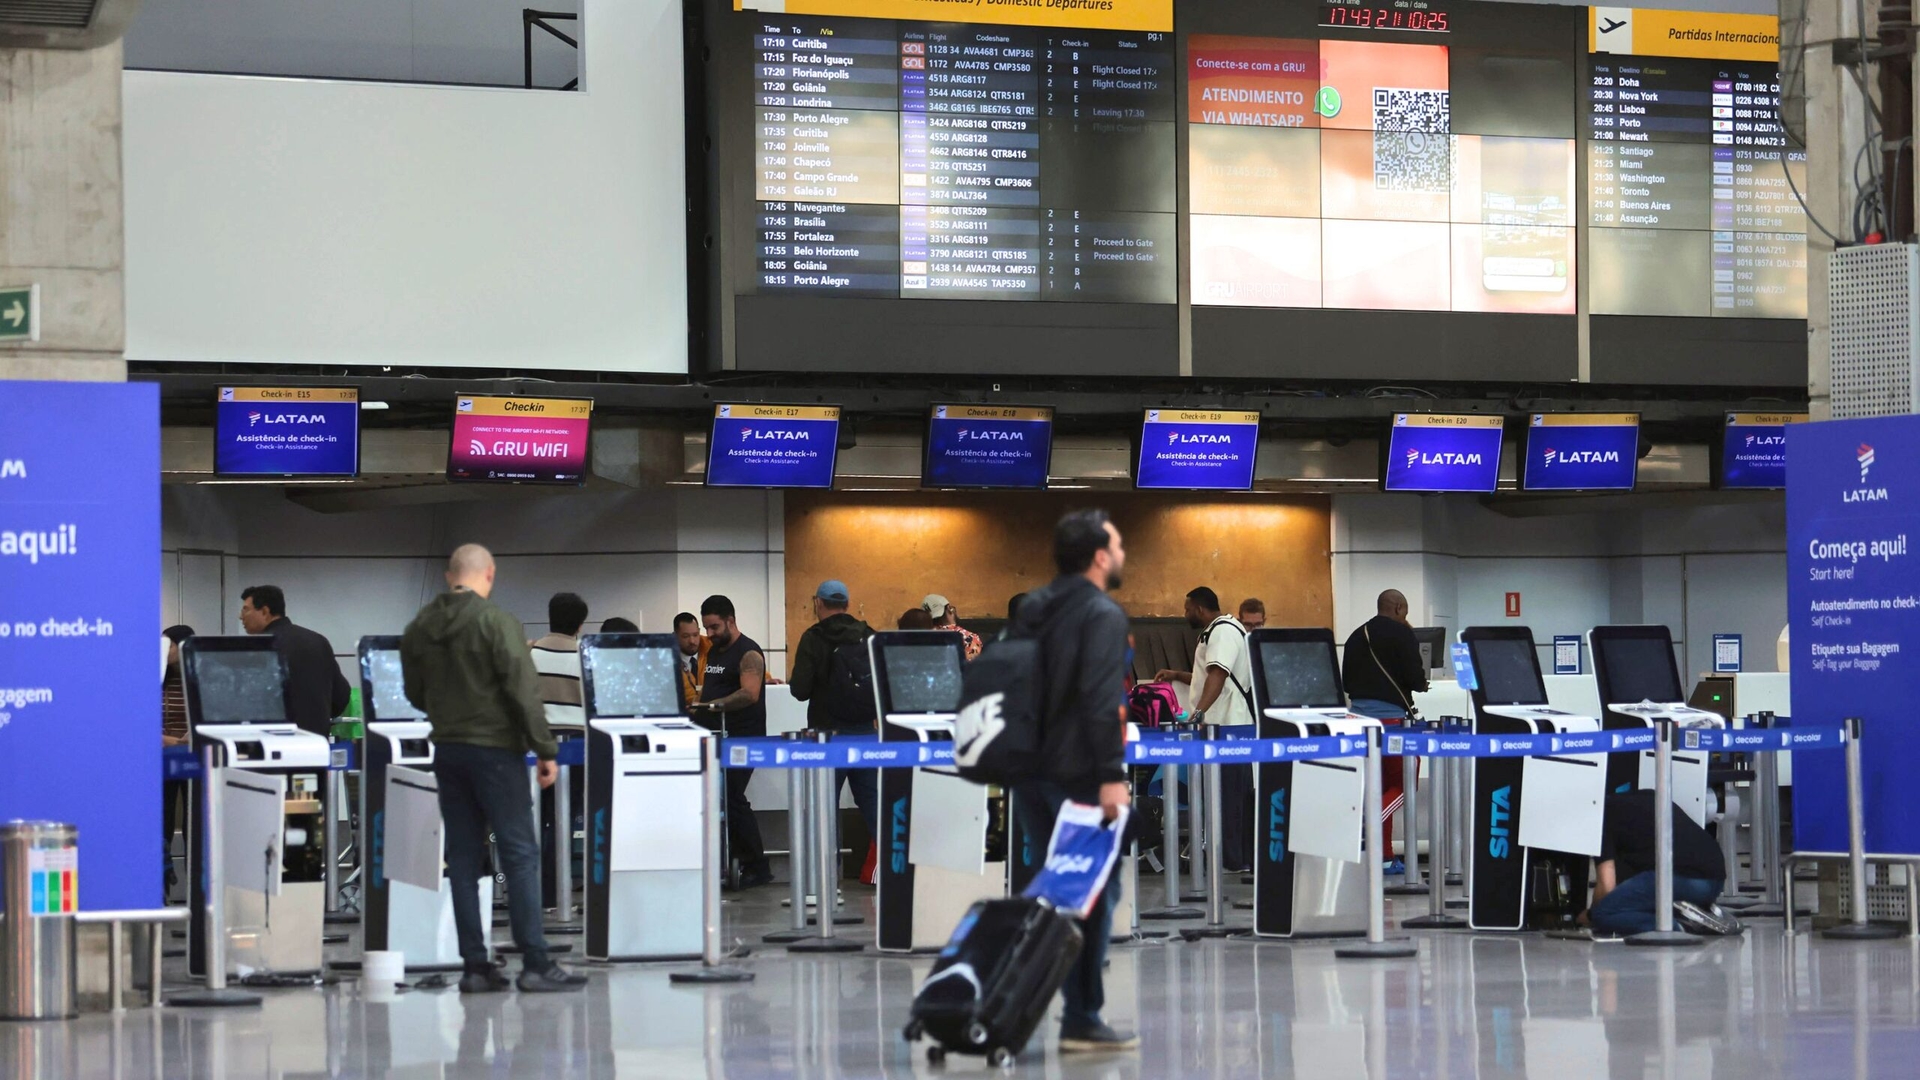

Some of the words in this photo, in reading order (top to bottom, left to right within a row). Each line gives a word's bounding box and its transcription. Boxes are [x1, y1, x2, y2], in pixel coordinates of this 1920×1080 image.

[1046, 0, 1113, 11] Departures
[1394, 0, 1408, 8] data
[1414, 1, 1428, 9] date
[764, 26, 781, 34] Time
[792, 26, 801, 34] To
[1669, 27, 1712, 42] Partidas
[762, 38, 785, 47] 17:10
[792, 39, 827, 50] Curitiba
[1062, 39, 1089, 48] Check-in
[762, 53, 785, 62] 17:15
[792, 53, 808, 63] Foz
[810, 54, 821, 64] do
[824, 55, 853, 66] Iguaçu
[1196, 58, 1249, 71] Conecte-se
[1251, 61, 1272, 71] com
[1274, 62, 1279, 72] a
[1282, 62, 1306, 74] GRU!
[763, 68, 785, 77] 17:20
[792, 68, 849, 80] Florianópolis
[928, 74, 948, 83] 4518
[950, 74, 986, 84] ARG8117
[763, 82, 785, 91] 17:20
[793, 82, 826, 93] Goiânia
[1593, 77, 1613, 87] 20:20
[1619, 78, 1640, 88] Doha
[929, 88, 948, 98] 3544
[950, 88, 987, 99] ARG8124
[990, 90, 1025, 101] QTR5181
[1201, 87, 1304, 105] ATENDIMENTO
[1594, 91, 1613, 100] 20:30
[1619, 92, 1639, 101] Nova
[1640, 92, 1658, 102] York
[763, 97, 785, 106] 17:20
[793, 97, 832, 108] Londrina
[1594, 104, 1613, 114] 20:45
[1619, 105, 1646, 115] Lisboa
[763, 113, 786, 122] 17:30
[793, 113, 817, 124] Porto
[820, 114, 849, 125] Alegre
[1202, 110, 1226, 126] VIA
[1230, 112, 1305, 127] WHATSAPP
[1594, 118, 1613, 127] 20:55
[1619, 118, 1641, 128] Porto
[763, 127, 786, 136] 17:35
[793, 128, 828, 138] Curitiba
[1594, 131, 1614, 141] 21:00
[1620, 132, 1648, 142] Newark
[764, 142, 786, 151] 17:40
[793, 142, 829, 153] Joinville
[1620, 146, 1654, 158] Santiago
[764, 157, 786, 166] 17:40
[793, 157, 831, 168] Chapecó
[1620, 160, 1643, 170] Miami
[764, 171, 786, 180] 17:40
[794, 172, 825, 184] Campo
[828, 173, 859, 183] Grande
[1620, 173, 1665, 185] Washington
[764, 186, 786, 195] 17:45
[794, 186, 824, 197] Galeão
[826, 187, 837, 197] RJ
[1620, 186, 1650, 197] Toronto
[764, 203, 786, 211] 17:45
[794, 203, 846, 214] Navegantes
[1620, 200, 1649, 211] Buenos
[1651, 201, 1671, 211] Aires
[764, 217, 786, 226] 17:45
[794, 217, 826, 227] Brasília
[1620, 214, 1658, 225] Assunção
[764, 231, 786, 240] 17:55
[794, 232, 834, 242] Fortaleza
[764, 246, 786, 255] 17:55
[794, 246, 813, 256] Belo
[816, 247, 859, 257] Horizonte
[764, 261, 786, 270] 18:05
[794, 261, 827, 271] Goiânia
[764, 275, 786, 285] 18:15
[794, 276, 818, 285] Porto
[820, 277, 850, 287] Alegre
[261, 390, 292, 398] Check-in
[504, 401, 545, 412] Checkin
[787, 408, 798, 416] E17
[265, 415, 326, 424] LATAM
[1180, 412, 1207, 420] Check-in
[300, 435, 337, 443] check-in
[755, 431, 809, 440] LATAM
[971, 431, 1024, 440] LATAM
[1181, 434, 1231, 443] LATAM
[533, 443, 568, 458] WIFI
[784, 449, 817, 458] check-in
[1422, 453, 1482, 465] LATAM
[1559, 451, 1619, 463] LATAM
[1843, 488, 1888, 503] LATAM
[0, 523, 78, 564] aqui!
[1809, 537, 1867, 563] Começa
[1870, 534, 1907, 562] aqui!
[1809, 567, 1831, 581] Start
[1833, 566, 1854, 580] here!
[1810, 599, 1879, 612] Autoatendimento
[1881, 599, 1891, 609] no
[1811, 615, 1824, 628] Self
[1825, 615, 1851, 626] Check-in
[14, 621, 37, 637] no
[40, 617, 113, 638] check-in
[1811, 643, 1844, 657] Etiquete
[1846, 644, 1860, 655] sua
[1862, 642, 1900, 657] Bagagem
[1838, 660, 1852, 671] your
[1564, 737, 1594, 749] decolar
[1624, 734, 1653, 746] decolar
[1735, 735, 1764, 745] decolar
[1793, 733, 1822, 743] decolar
[1287, 743, 1319, 755] decolar
[1440, 739, 1471, 751] decolar
[1502, 739, 1533, 751] decolar
[791, 749, 826, 761] decolar
[863, 750, 898, 761] decolar
[1149, 746, 1184, 757] decolar
[1218, 746, 1252, 756] decolar
[1269, 786, 1286, 863] SITA
[1489, 783, 1512, 860] SITA
[891, 795, 907, 875] SITA
